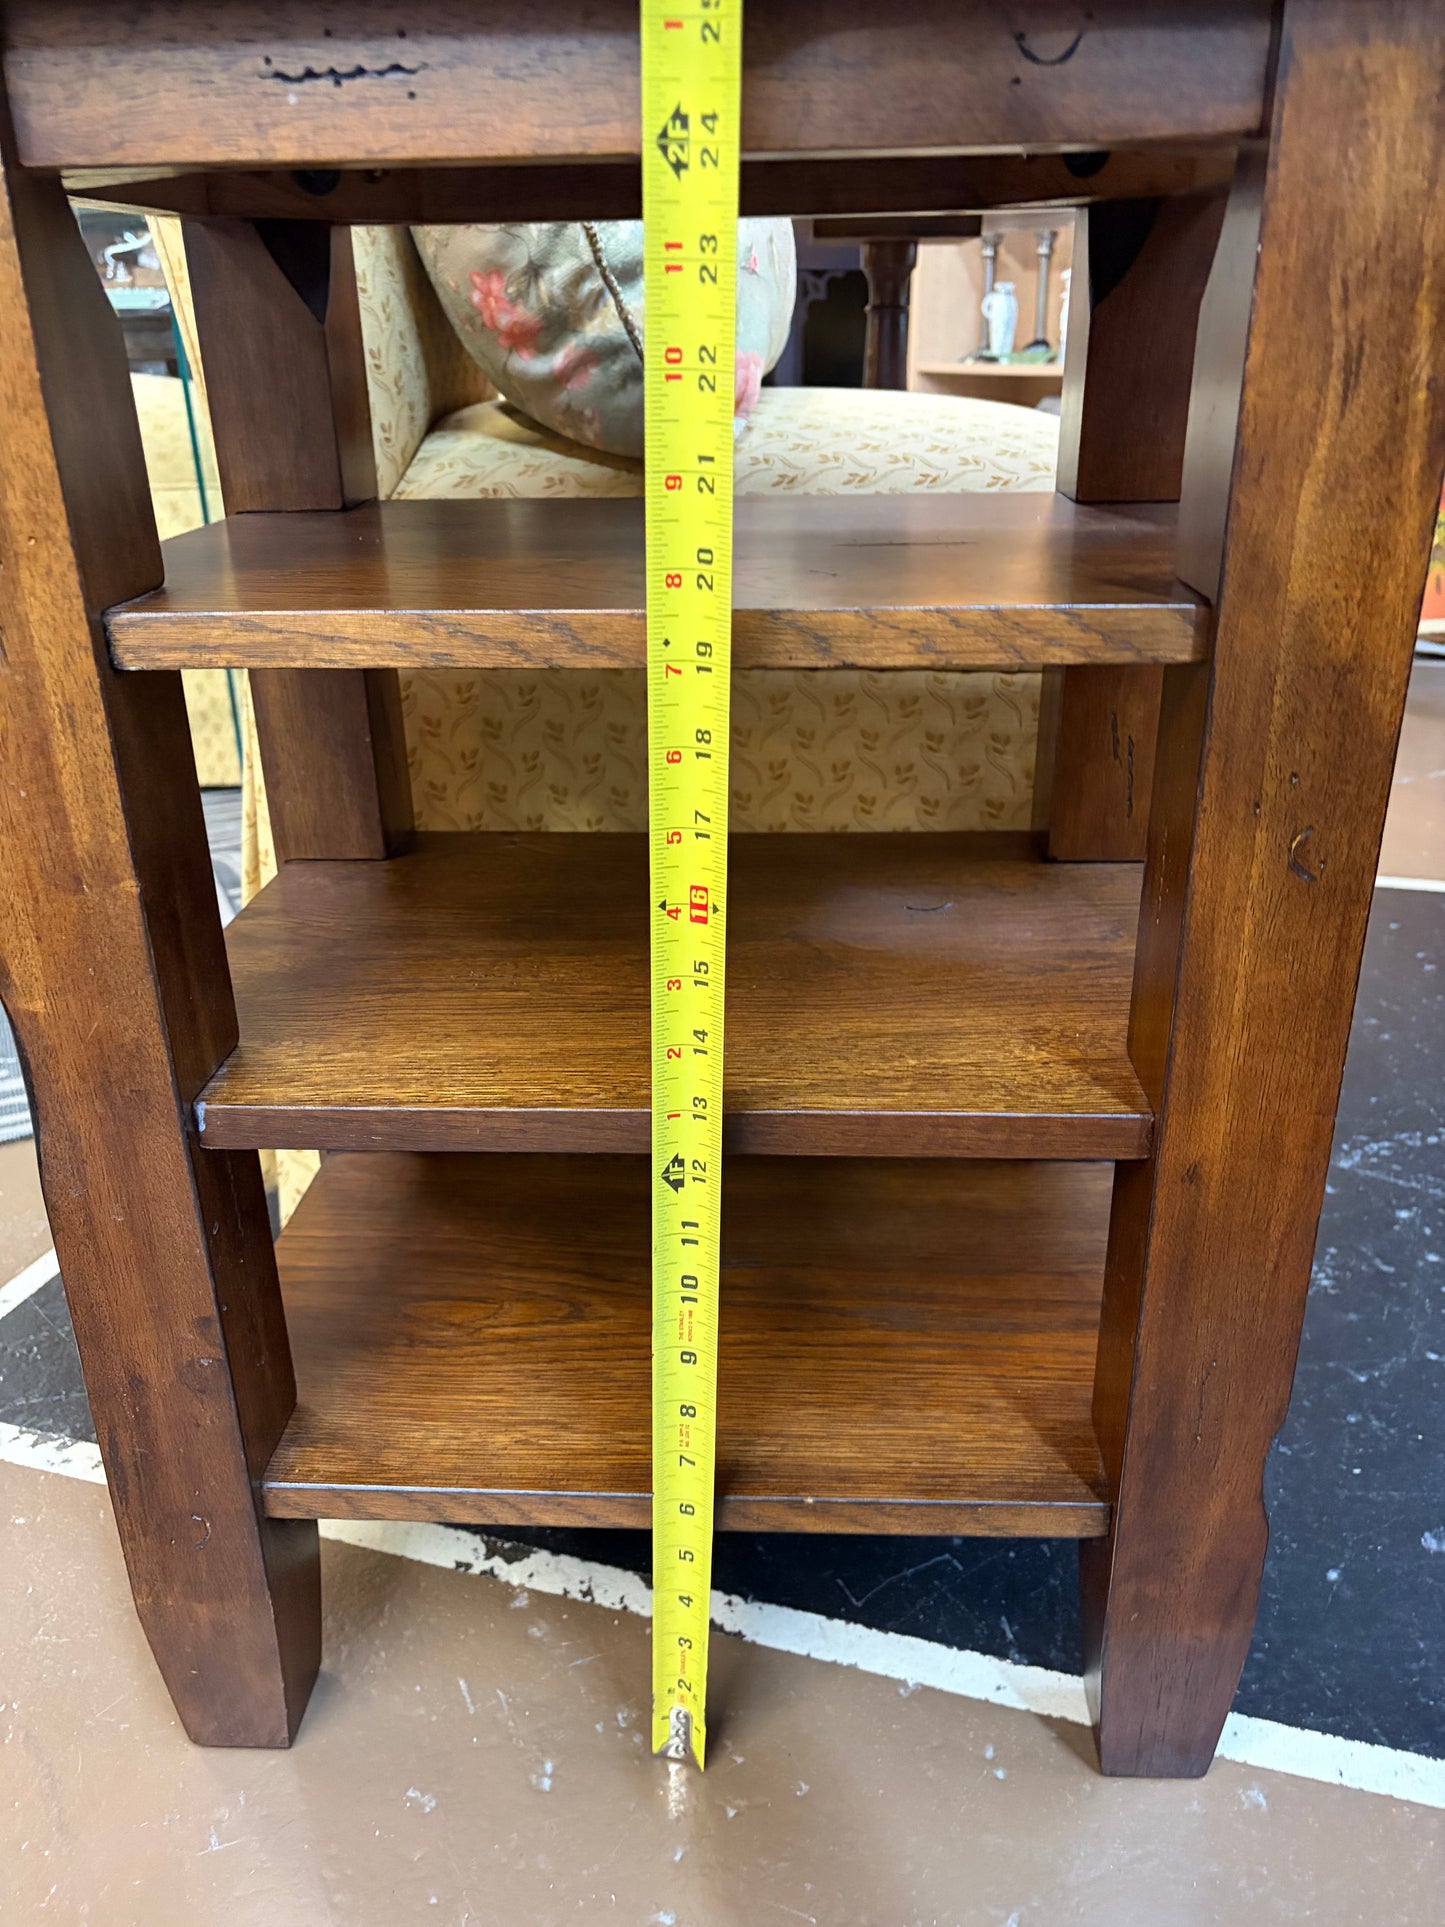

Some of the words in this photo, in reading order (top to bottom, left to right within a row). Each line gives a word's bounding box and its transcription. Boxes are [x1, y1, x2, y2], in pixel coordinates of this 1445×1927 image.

[700, 109, 719, 168] 24
[664, 241, 683, 274] 11
[699, 233, 718, 285] 23
[664, 347, 683, 383] 10
[698, 344, 717, 392] 22
[664, 474, 682, 491] 9
[697, 454, 715, 495] 21
[665, 573, 682, 589] 8
[696, 547, 714, 591] 20
[696, 641, 713, 674] 19
[665, 663, 682, 679] 7
[695, 728, 712, 760] 18
[666, 750, 682, 764] 6
[666, 831, 682, 844] 5
[694, 810, 711, 840] 17
[666, 906, 682, 920] 4
[690, 887, 708, 921] 16
[666, 979, 682, 991] 3
[693, 960, 709, 987] 15
[666, 1047, 682, 1059] 2
[693, 1029, 708, 1056] 14
[666, 1113, 681, 1121] 1
[692, 1096, 707, 1121] 13
[668, 1159, 684, 1184] 1F
[692, 1159, 707, 1184] 12
[680, 1220, 699, 1246] 11
[680, 1275, 698, 1304] 10
[680, 1350, 697, 1365] 9
[680, 1404, 697, 1418] 8
[679, 1454, 696, 1467] 7
[679, 1503, 695, 1516] 6
[678, 1549, 694, 1562] 5
[678, 1594, 693, 1608] 4
[678, 1636, 692, 1650] 3
[677, 1678, 692, 1692] 2
